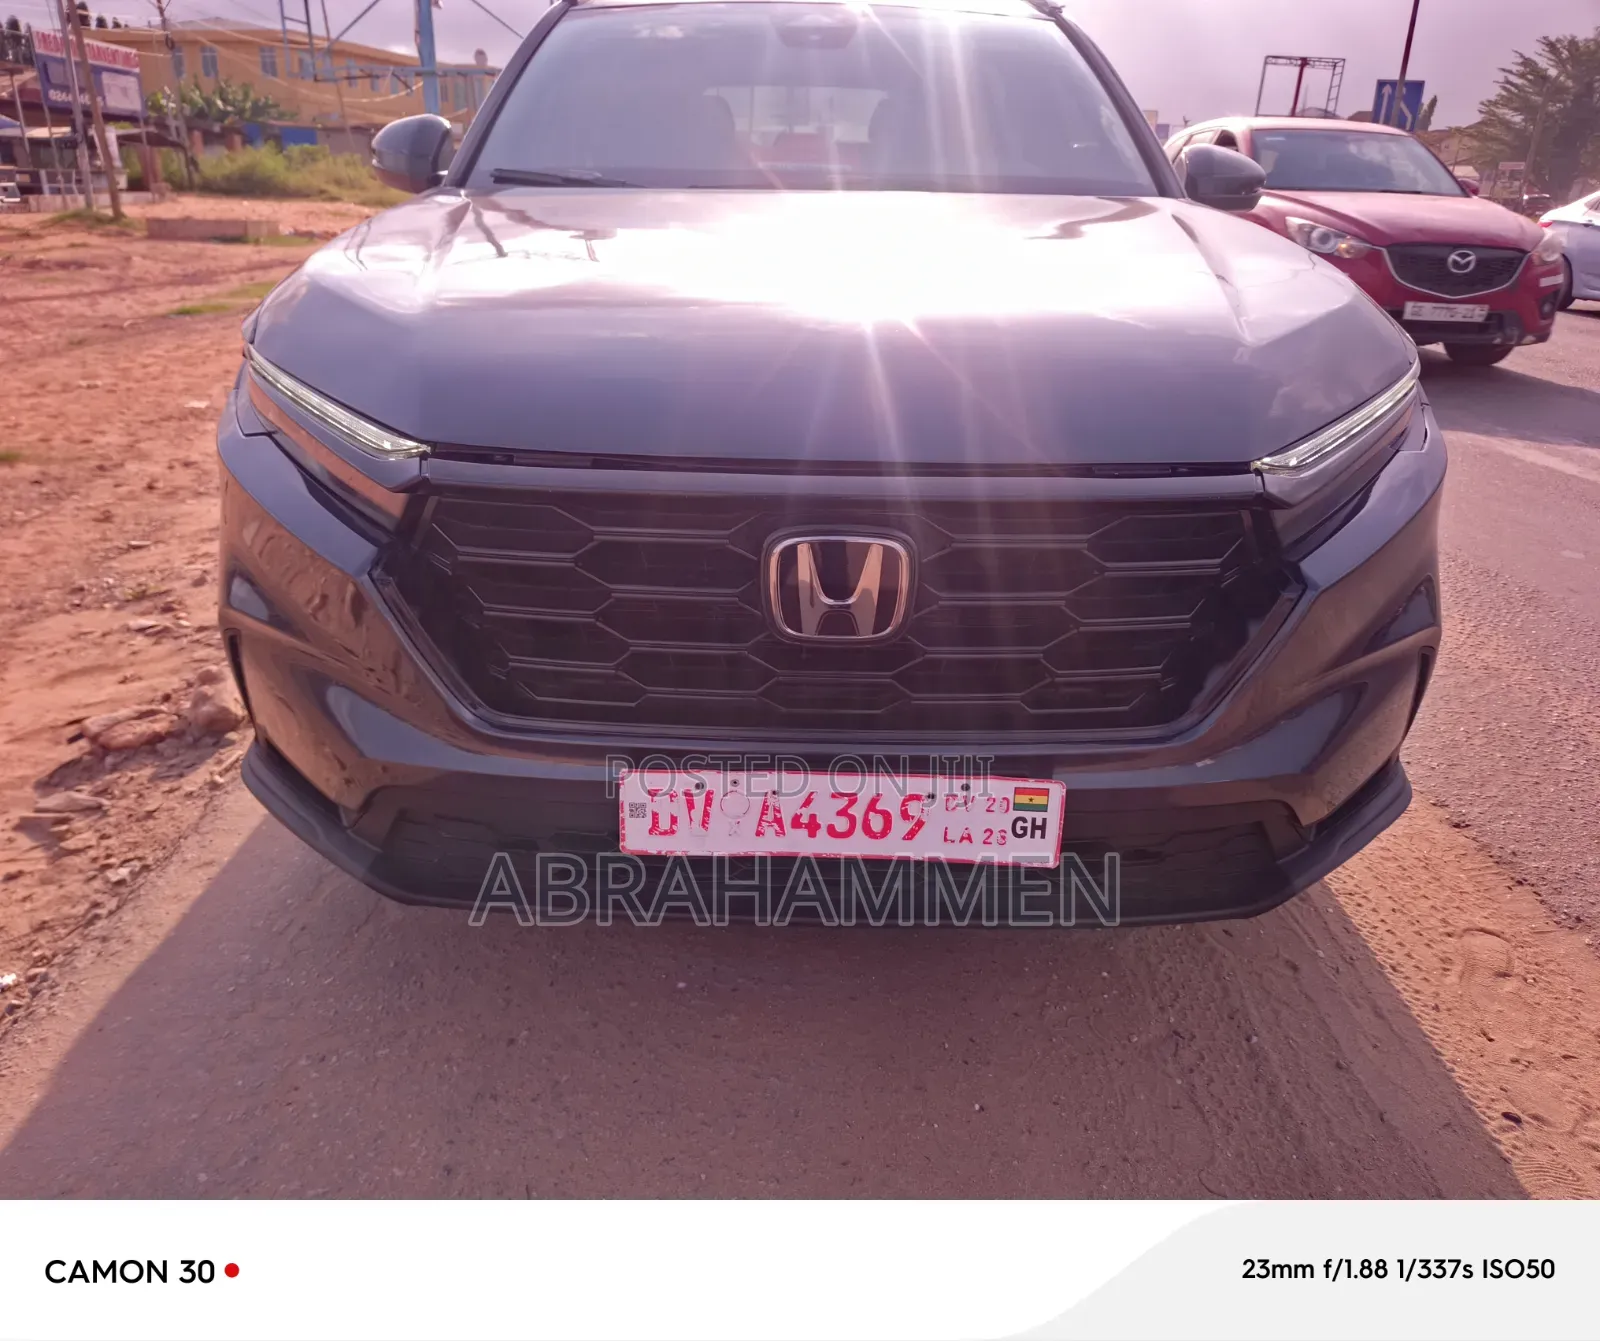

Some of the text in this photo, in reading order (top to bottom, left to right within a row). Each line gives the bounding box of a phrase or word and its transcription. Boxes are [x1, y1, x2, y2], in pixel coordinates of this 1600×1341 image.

[755, 790, 927, 841] A4369
[943, 826, 974, 844] LA
[1011, 816, 1048, 840] GH
